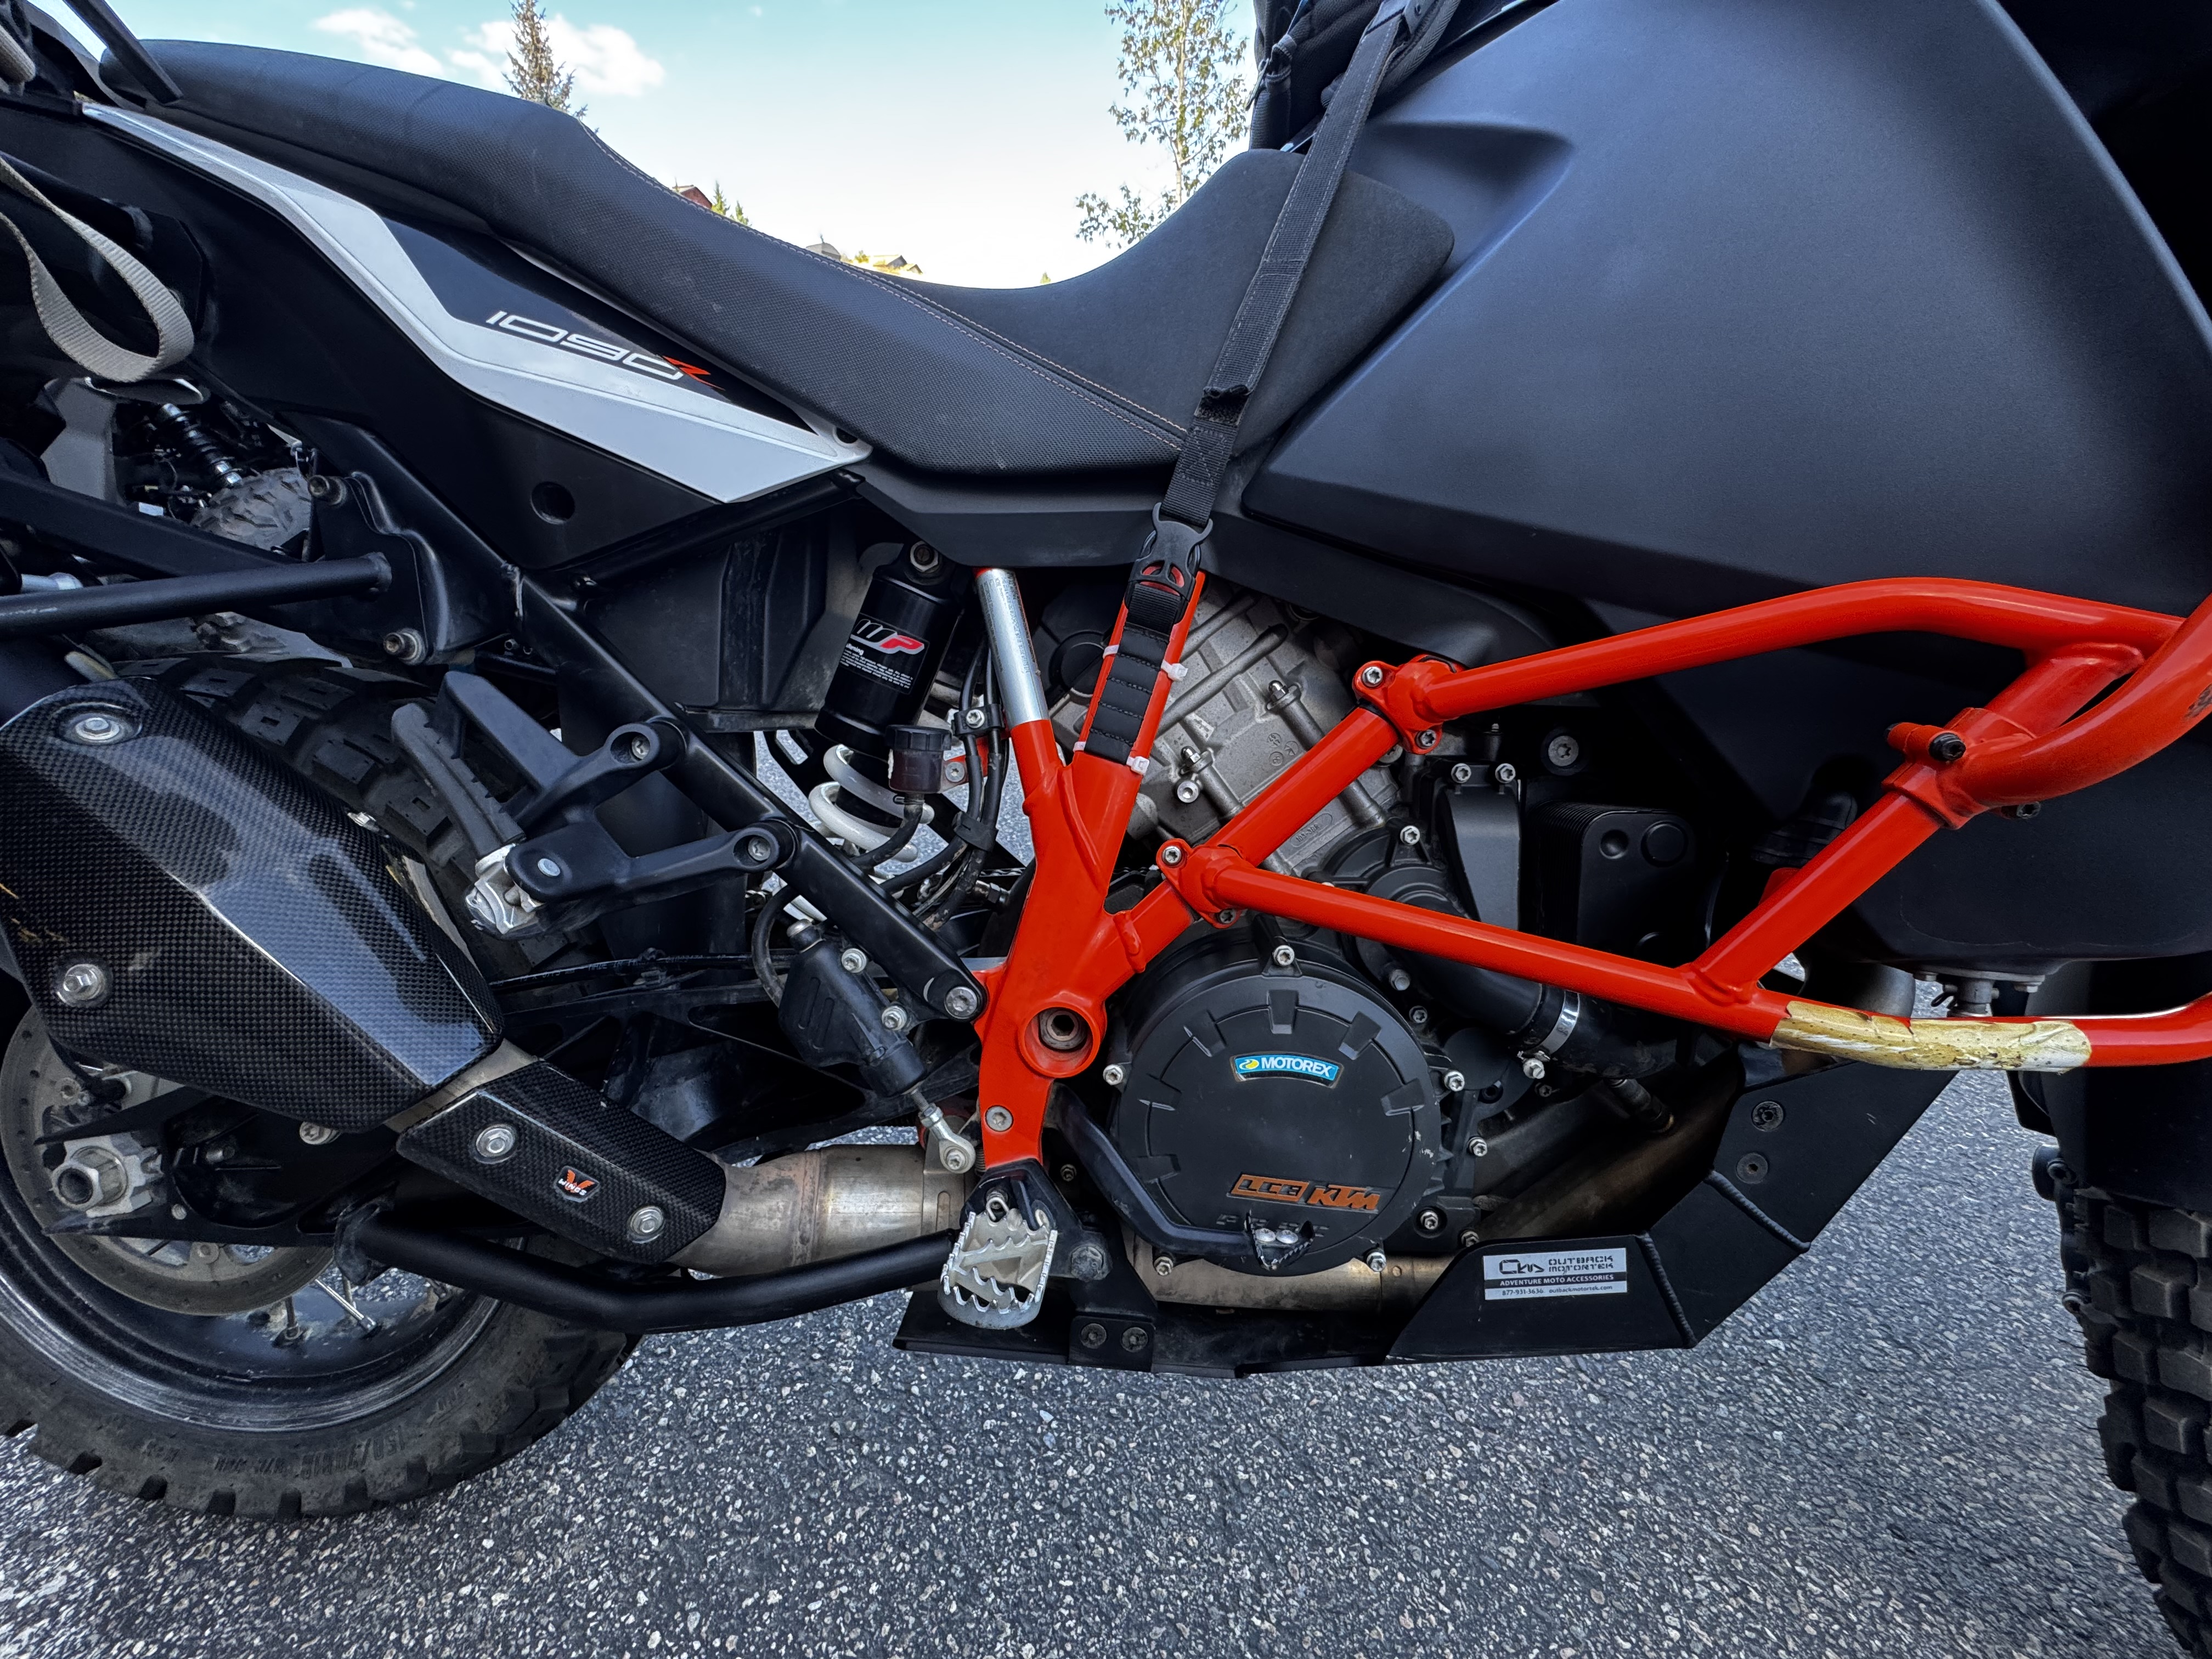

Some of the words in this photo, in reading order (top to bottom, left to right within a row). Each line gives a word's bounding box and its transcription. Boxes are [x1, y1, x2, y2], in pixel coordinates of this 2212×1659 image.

[1261, 1057, 1334, 1077] MOTOREX
[558, 1178, 587, 1196] WINGS
[1307, 1184, 1381, 1210] KTM
[1548, 1255, 1613, 1266] OUTBACK
[1548, 1263, 1614, 1272] MOTORTEK
[1499, 1278, 1542, 1286] ADVENTURE
[1566, 1274, 1615, 1283] ACCESSORIES
[1549, 1285, 1613, 1294] outbackmotortek.com
